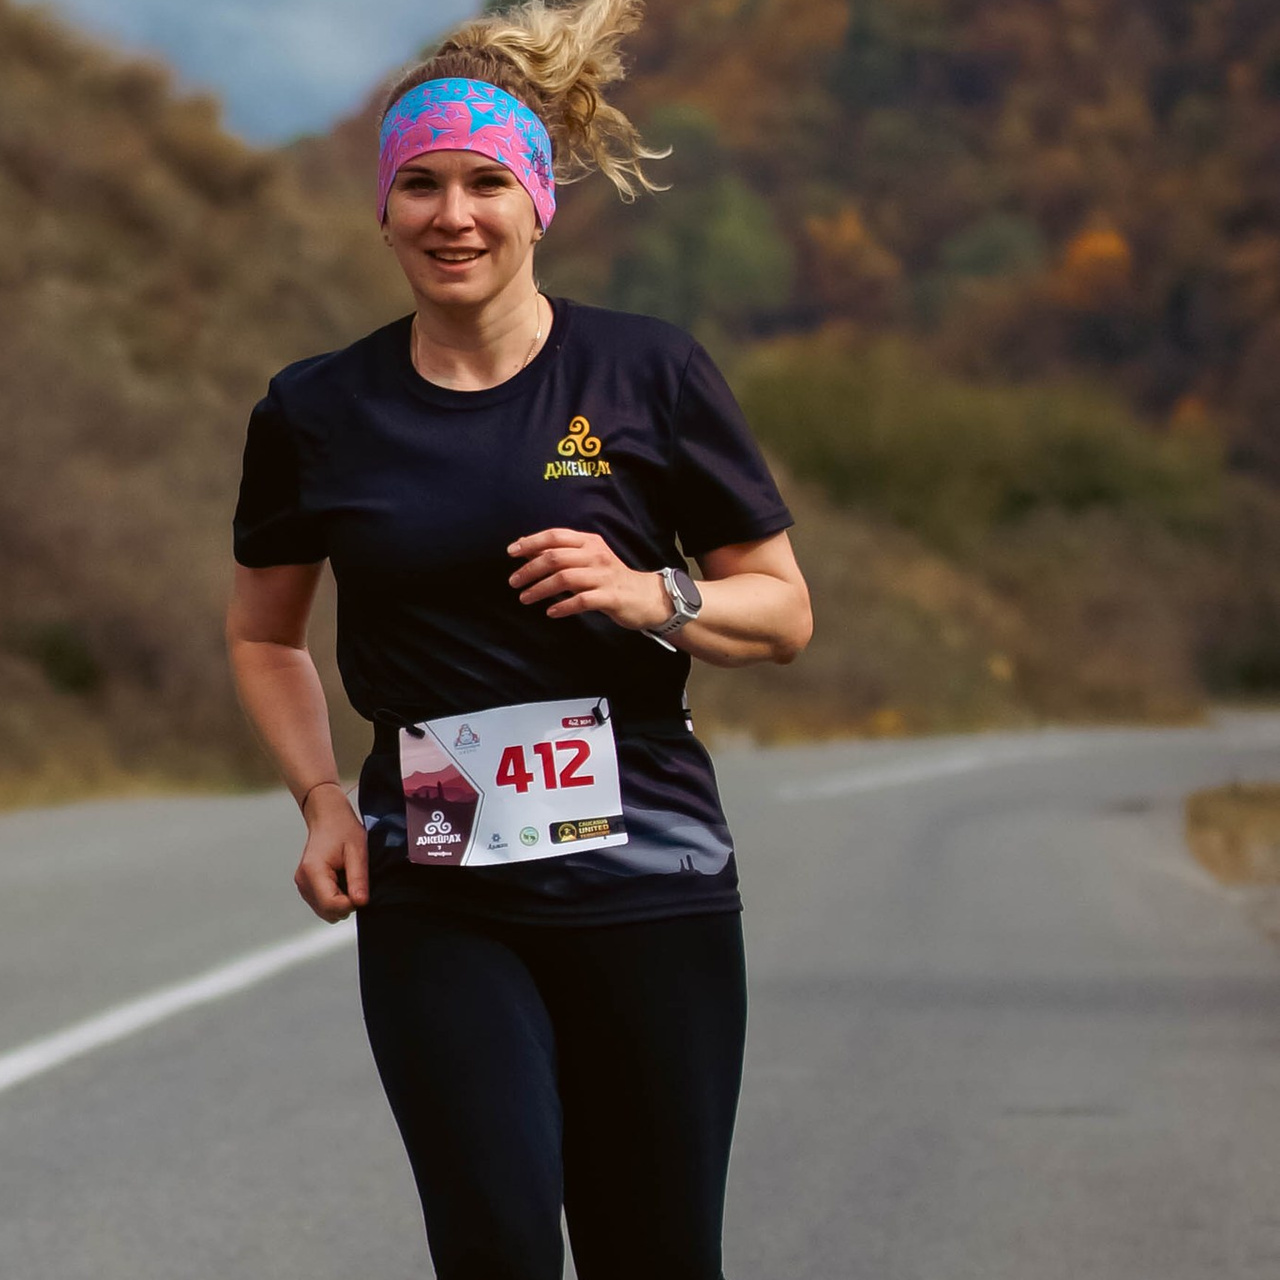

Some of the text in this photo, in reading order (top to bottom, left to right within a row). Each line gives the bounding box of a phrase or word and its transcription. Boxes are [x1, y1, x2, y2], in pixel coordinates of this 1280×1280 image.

[495, 739, 595, 794] 412
[578, 824, 610, 834] UNITED
[416, 833, 462, 846] ДЖЕЙРАХ
